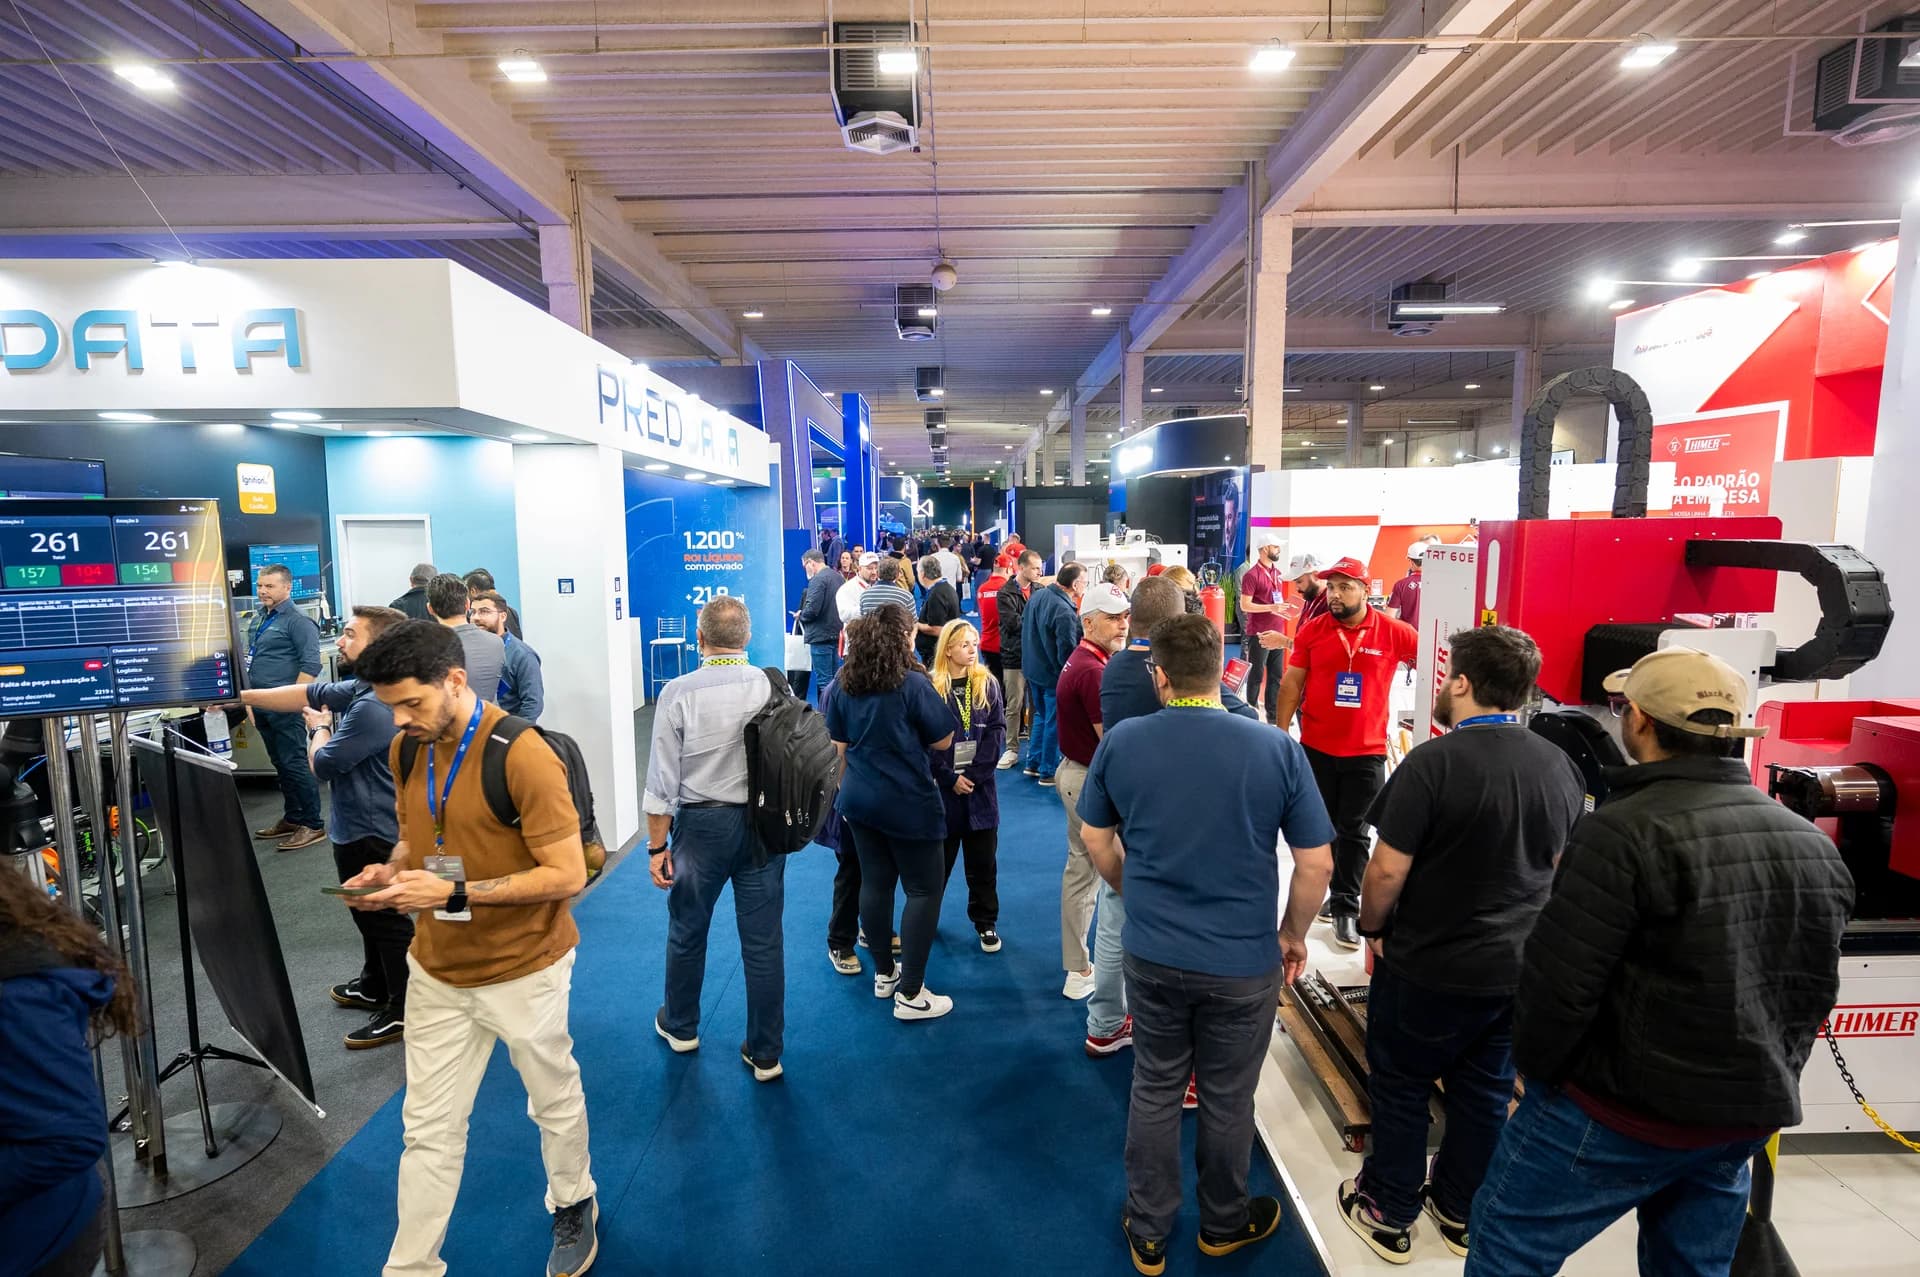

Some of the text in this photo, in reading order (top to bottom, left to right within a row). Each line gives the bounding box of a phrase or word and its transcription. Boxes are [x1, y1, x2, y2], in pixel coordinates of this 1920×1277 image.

[1683, 436, 1721, 452] THIMER
[1695, 470, 1760, 488] PADRÃO
[30, 532, 80, 552] 261
[144, 531, 189, 550] 261
[1426, 549, 1446, 561] TRT
[19, 567, 46, 578] 157
[76, 566, 102, 577] 104
[134, 565, 159, 575] 154
[684, 561, 744, 572] comprovado
[1819, 1010, 1919, 1033] HIMER
